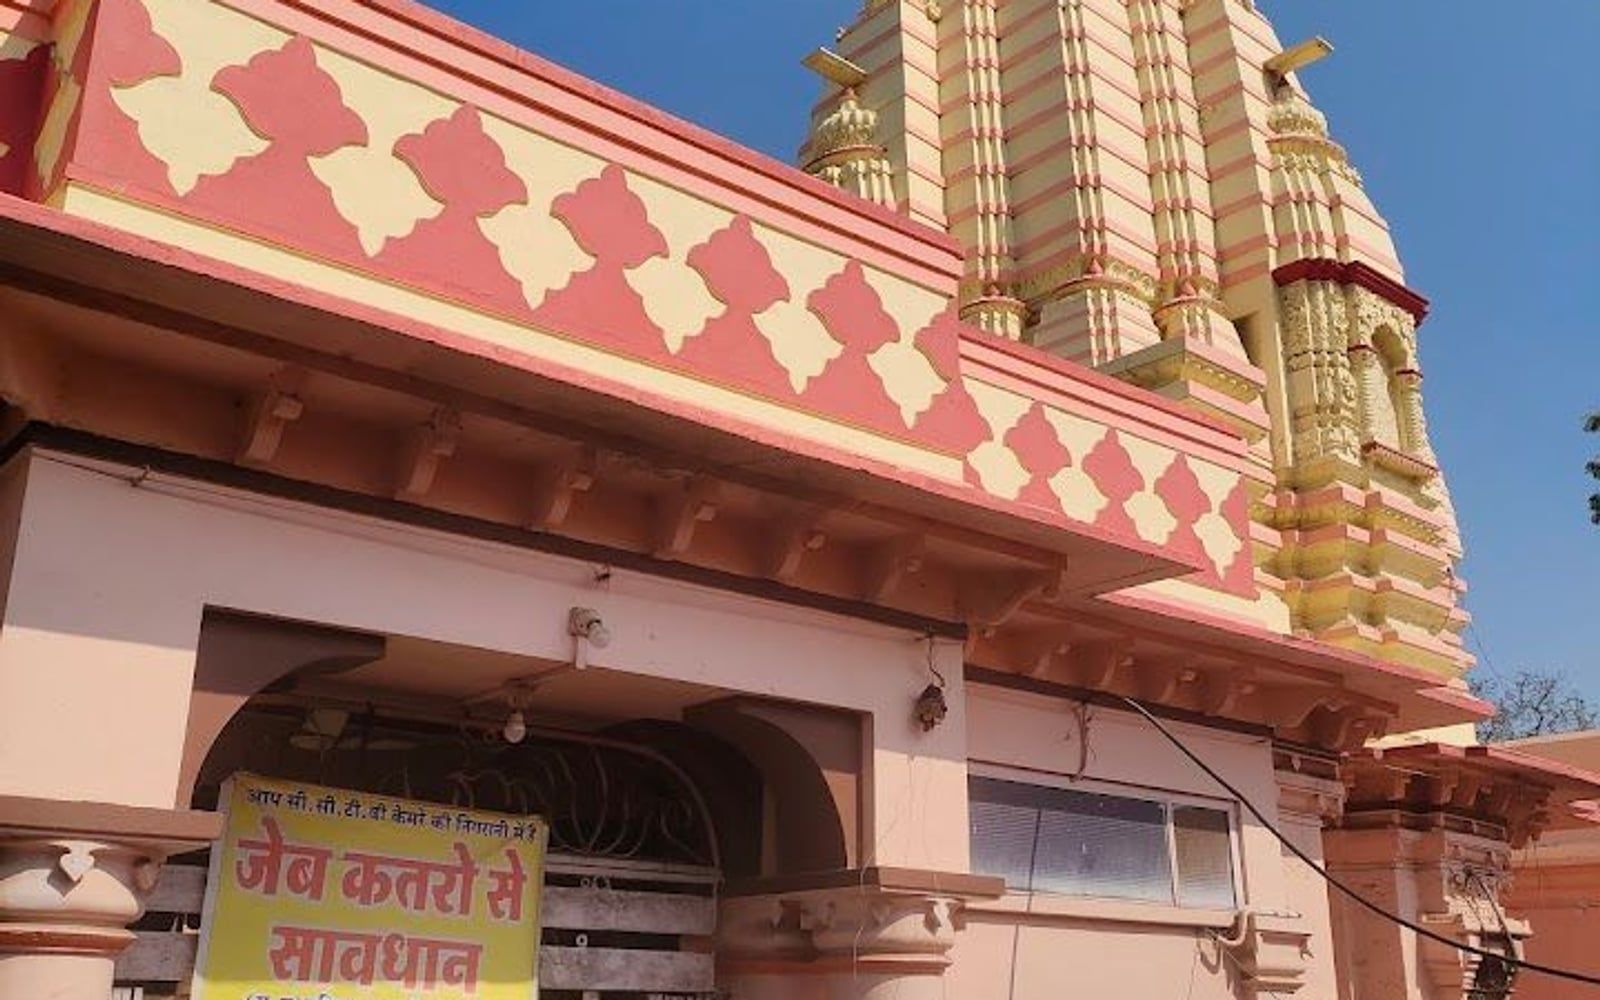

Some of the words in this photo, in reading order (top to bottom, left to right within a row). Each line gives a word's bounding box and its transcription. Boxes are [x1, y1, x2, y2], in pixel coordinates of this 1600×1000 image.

[249, 788, 282, 806] आप
[431, 812, 452, 829] की
[236, 817, 332, 901] जेब
[340, 844, 478, 915] कतरो
[486, 849, 527, 921] से
[269, 926, 483, 993] सावधान
